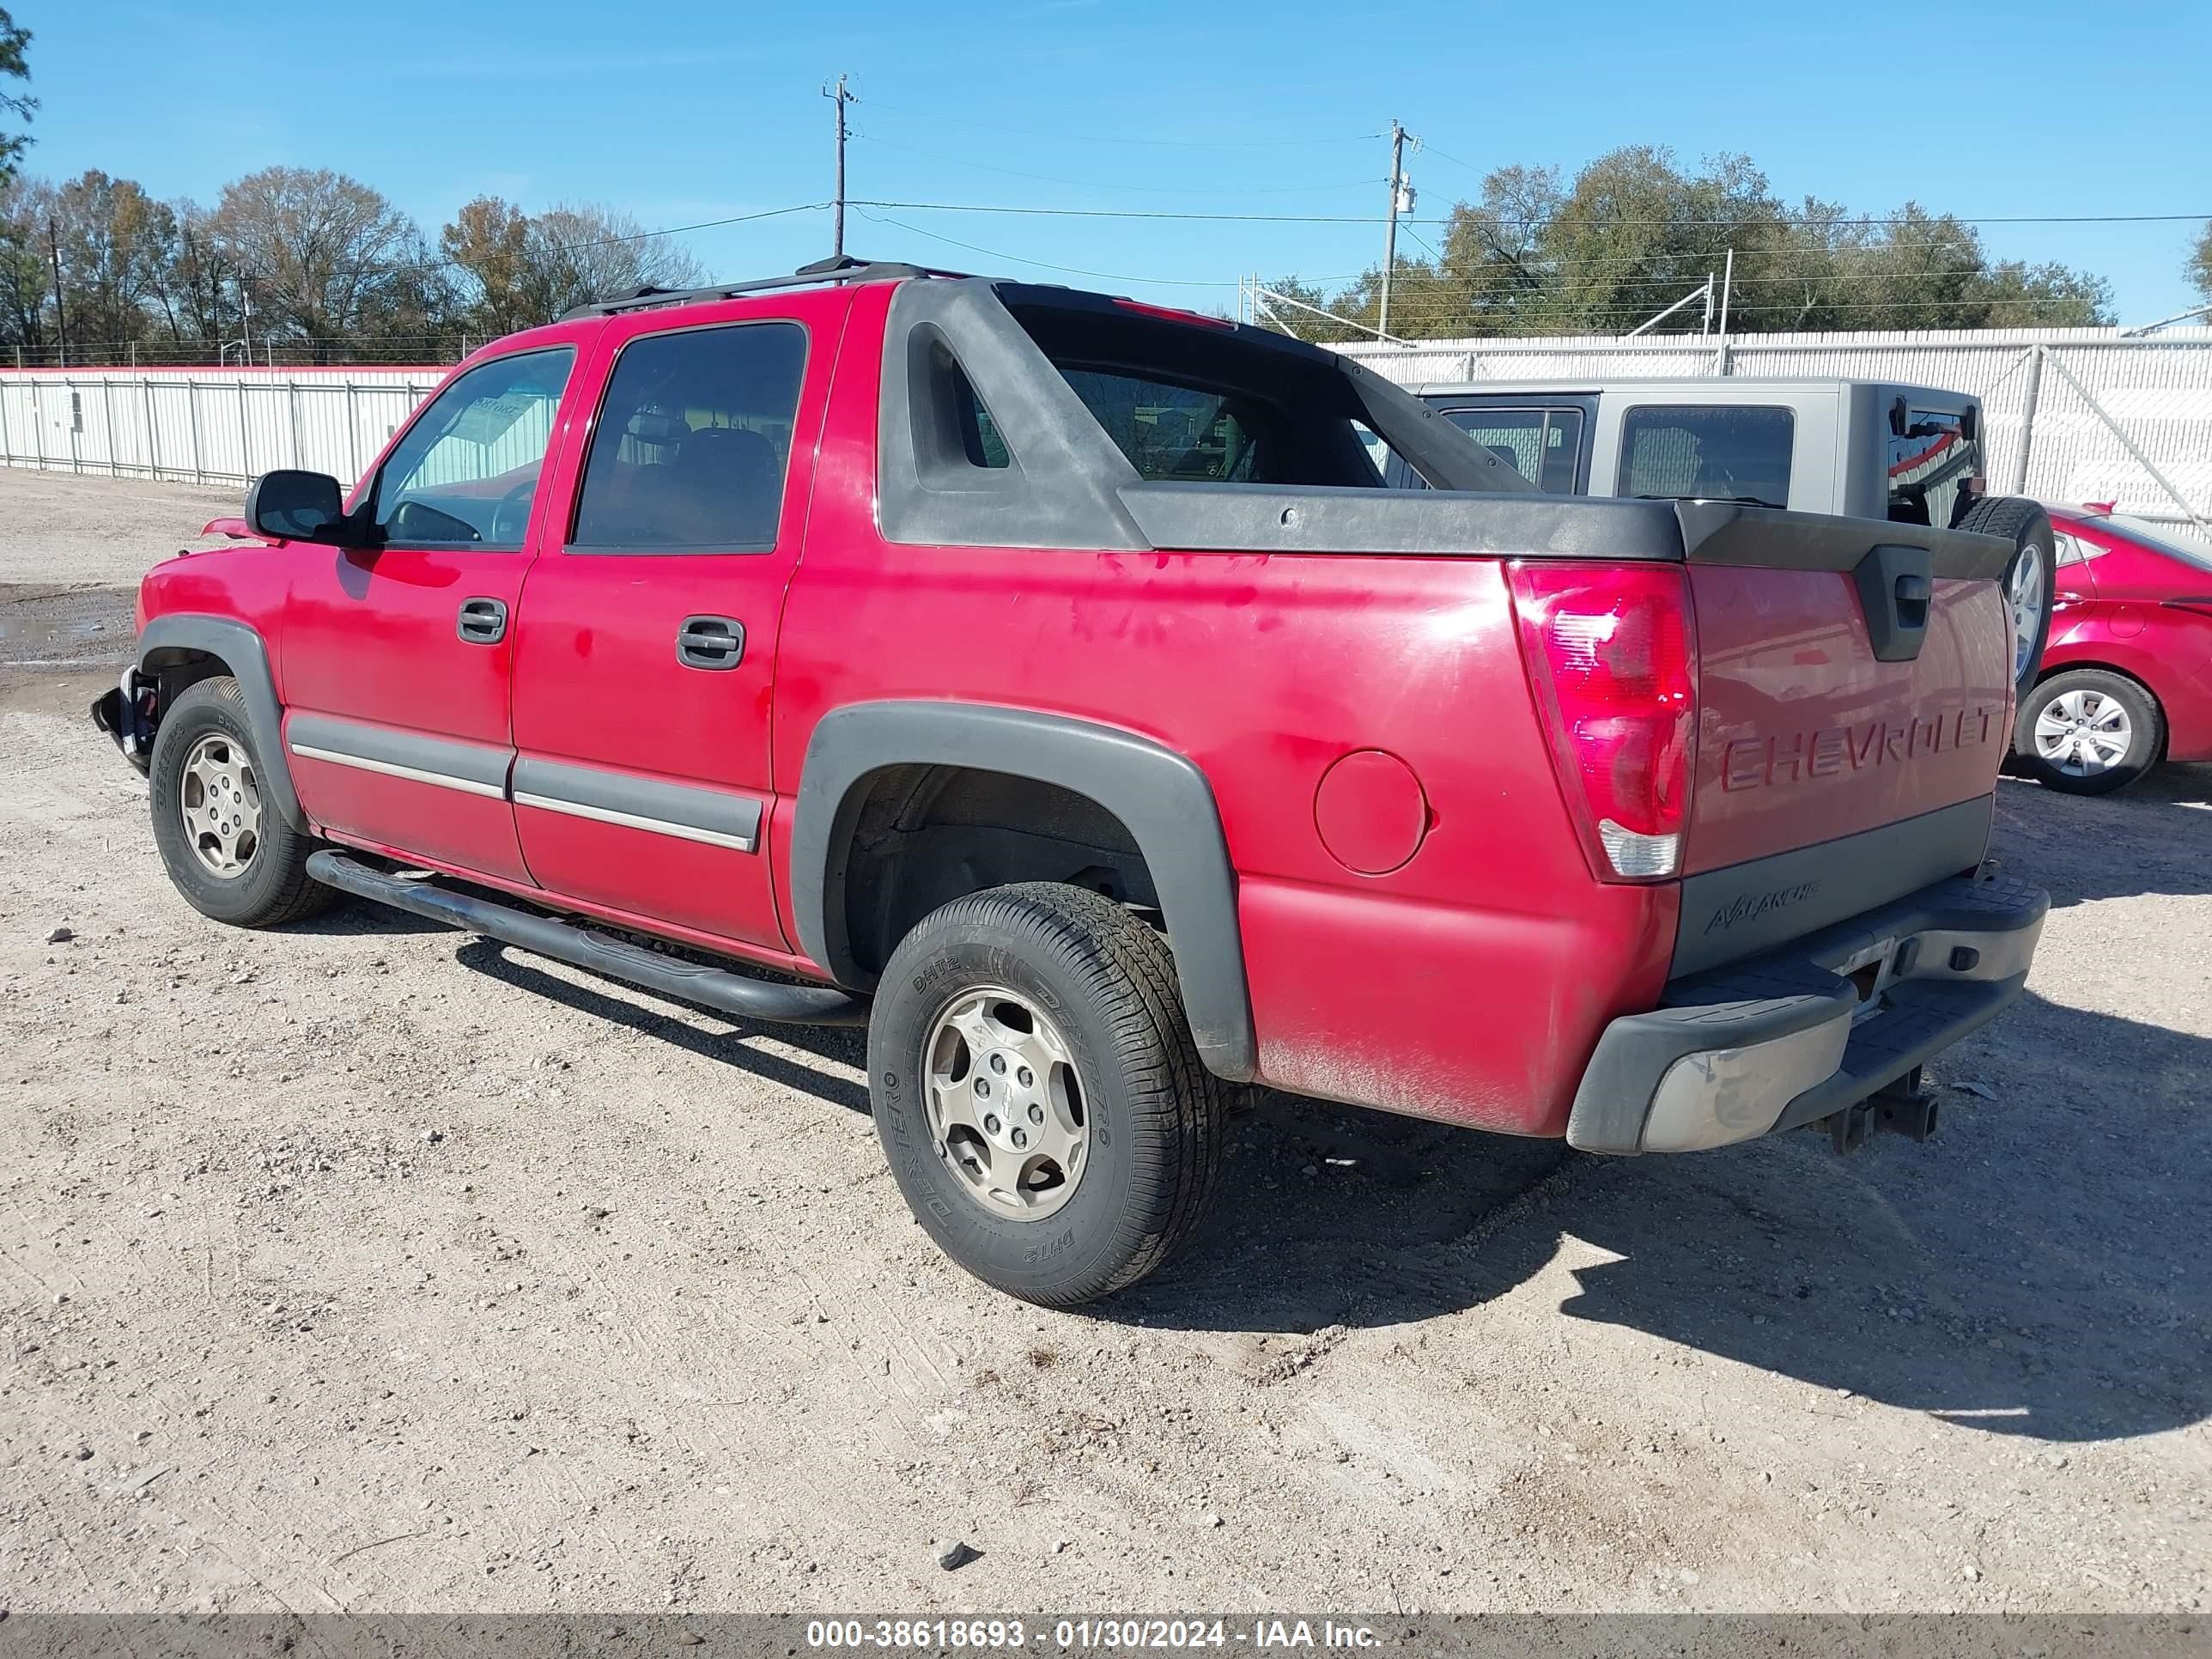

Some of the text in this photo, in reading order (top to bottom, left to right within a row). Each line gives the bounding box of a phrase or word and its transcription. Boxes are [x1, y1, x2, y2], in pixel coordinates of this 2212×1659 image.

[1721, 707, 1996, 793] CHEVROLET
[1704, 879, 1821, 936] AVALANCHE
[912, 954, 961, 994] DHT2
[884, 1072, 953, 1218] DEXTERO
